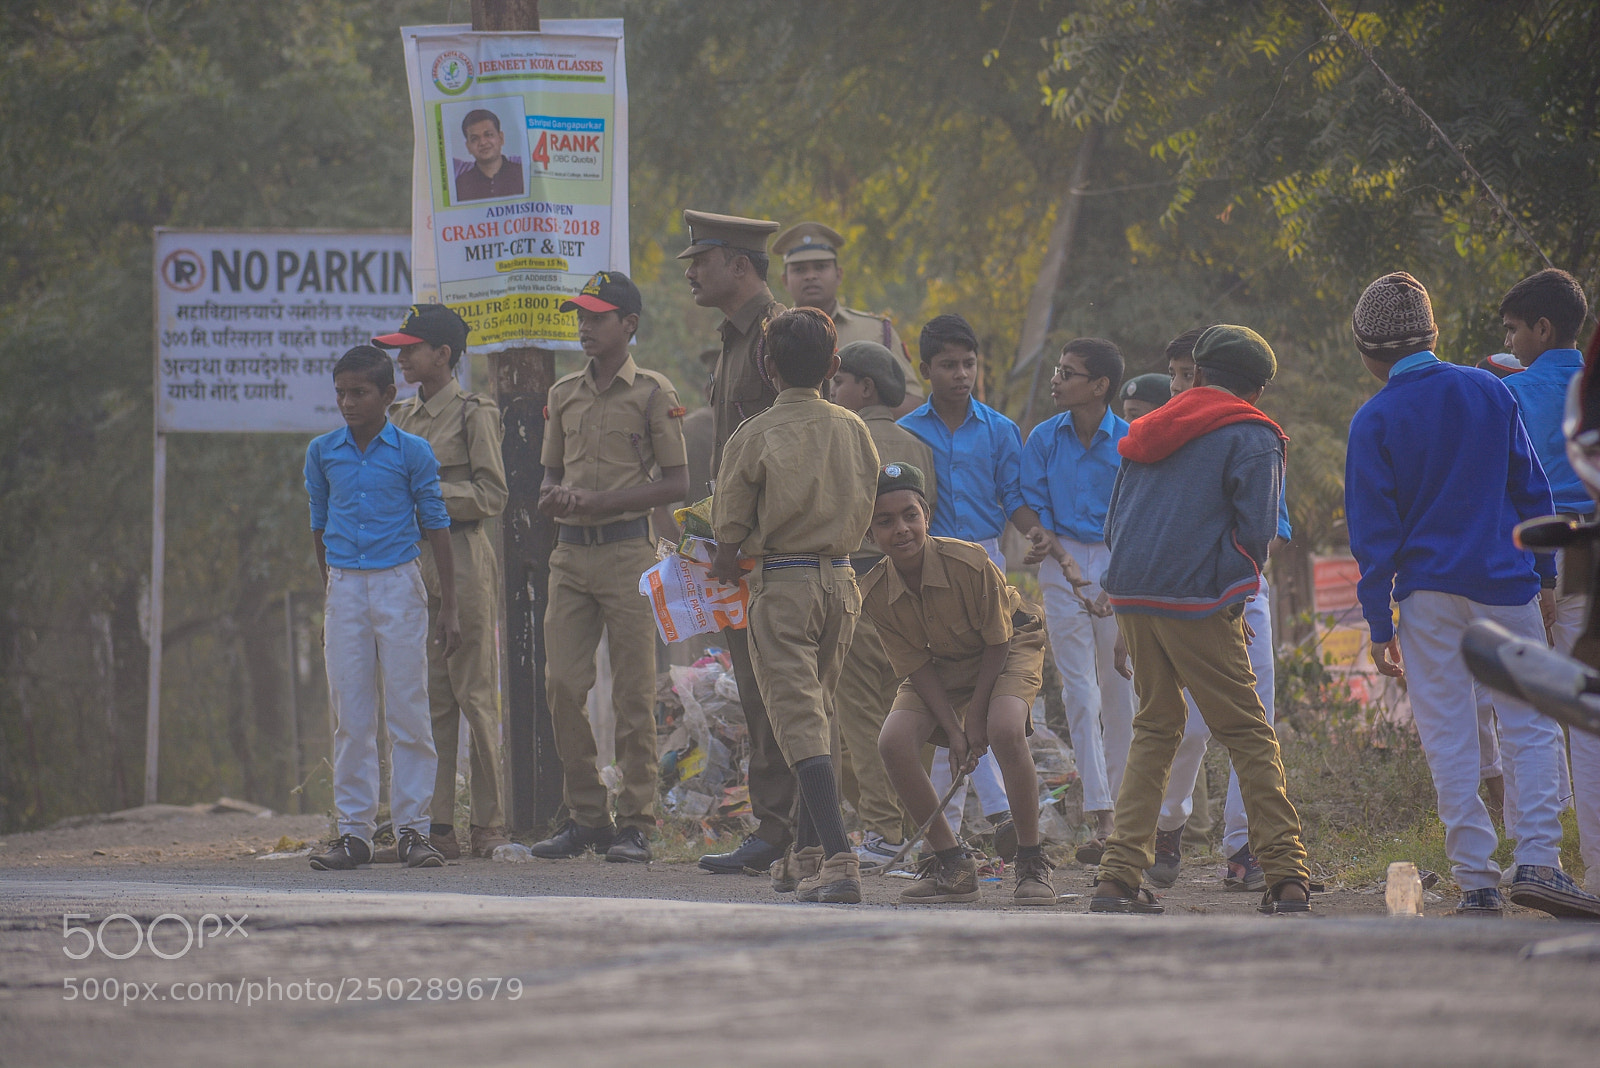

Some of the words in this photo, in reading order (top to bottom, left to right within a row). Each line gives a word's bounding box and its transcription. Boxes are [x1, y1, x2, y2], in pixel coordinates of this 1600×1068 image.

[478, 59, 526, 75] JEENEET
[530, 59, 555, 70] KOTA
[557, 59, 603, 72] CLASSES
[532, 130, 550, 170] 4
[550, 133, 600, 153] RANK
[486, 202, 552, 218] ADMISSION
[553, 204, 573, 216] PEN
[442, 221, 499, 242] CRASH
[465, 238, 536, 262] MHT-CET
[540, 238, 555, 255] &
[211, 250, 269, 292] NO
[277, 250, 412, 293] PARKIN
[680, 561, 696, 598] OFFICE
[689, 598, 707, 629] PAPER
